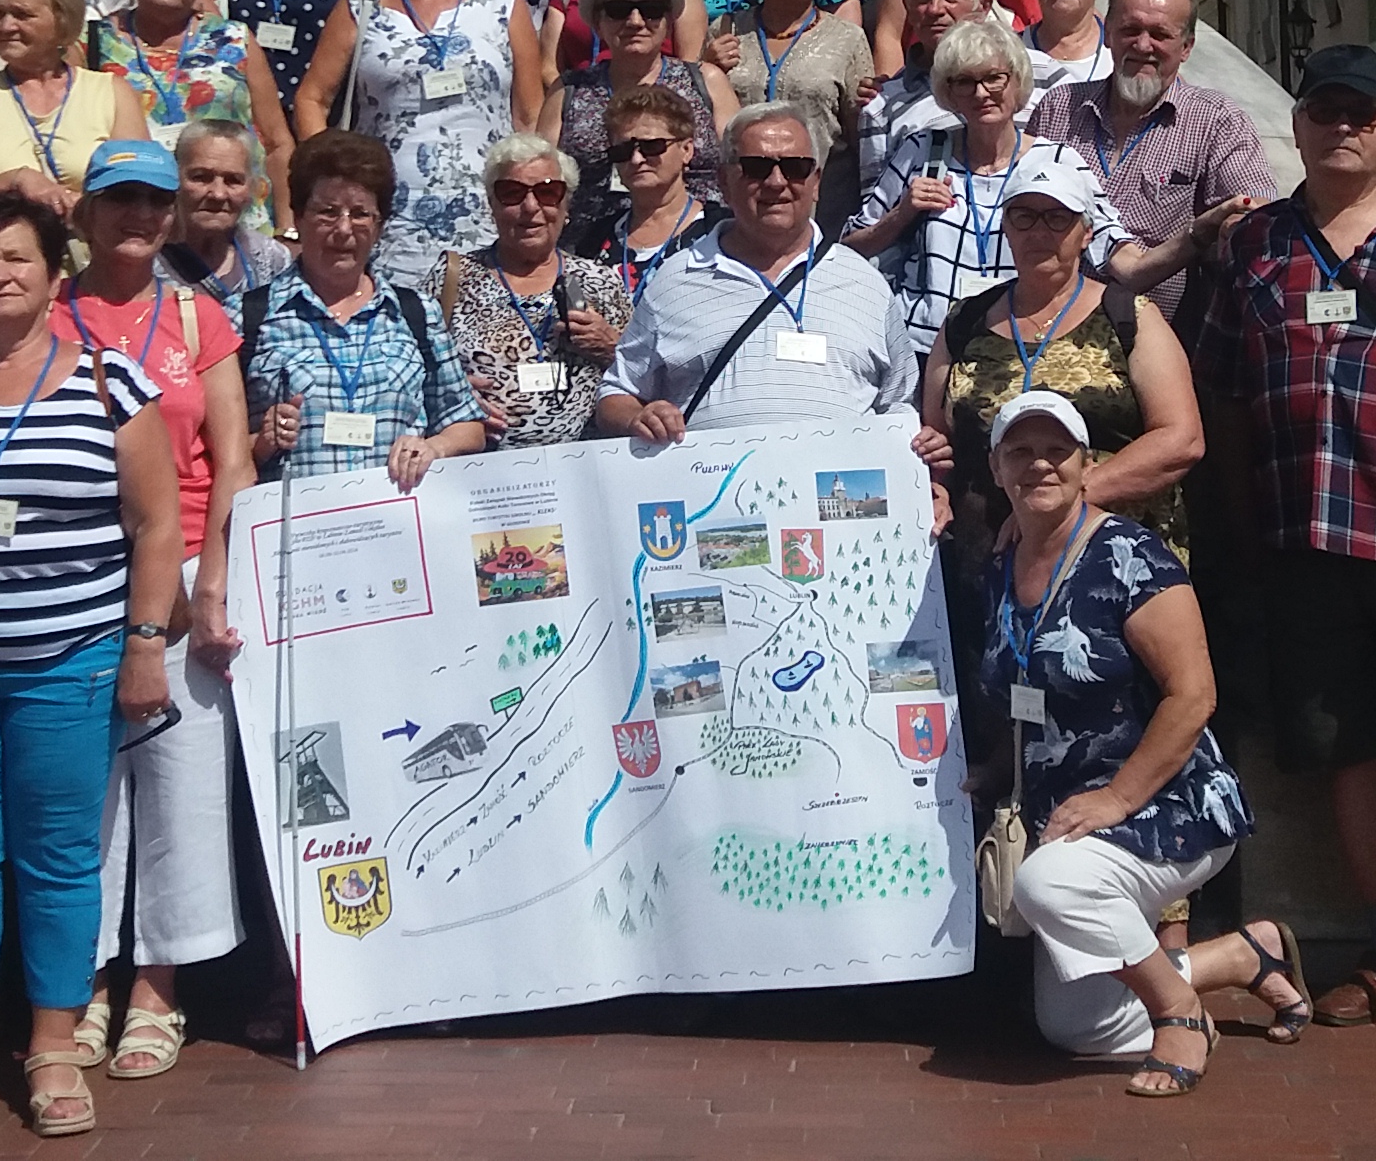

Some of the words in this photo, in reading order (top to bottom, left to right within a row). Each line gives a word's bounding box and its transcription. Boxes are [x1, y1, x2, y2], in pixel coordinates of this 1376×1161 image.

[504, 551, 527, 564] 20
[789, 592, 811, 600] LUBLIN
[527, 746, 586, 814] SANDOMIERZ
[628, 783, 666, 793] SANDOMIERZ
